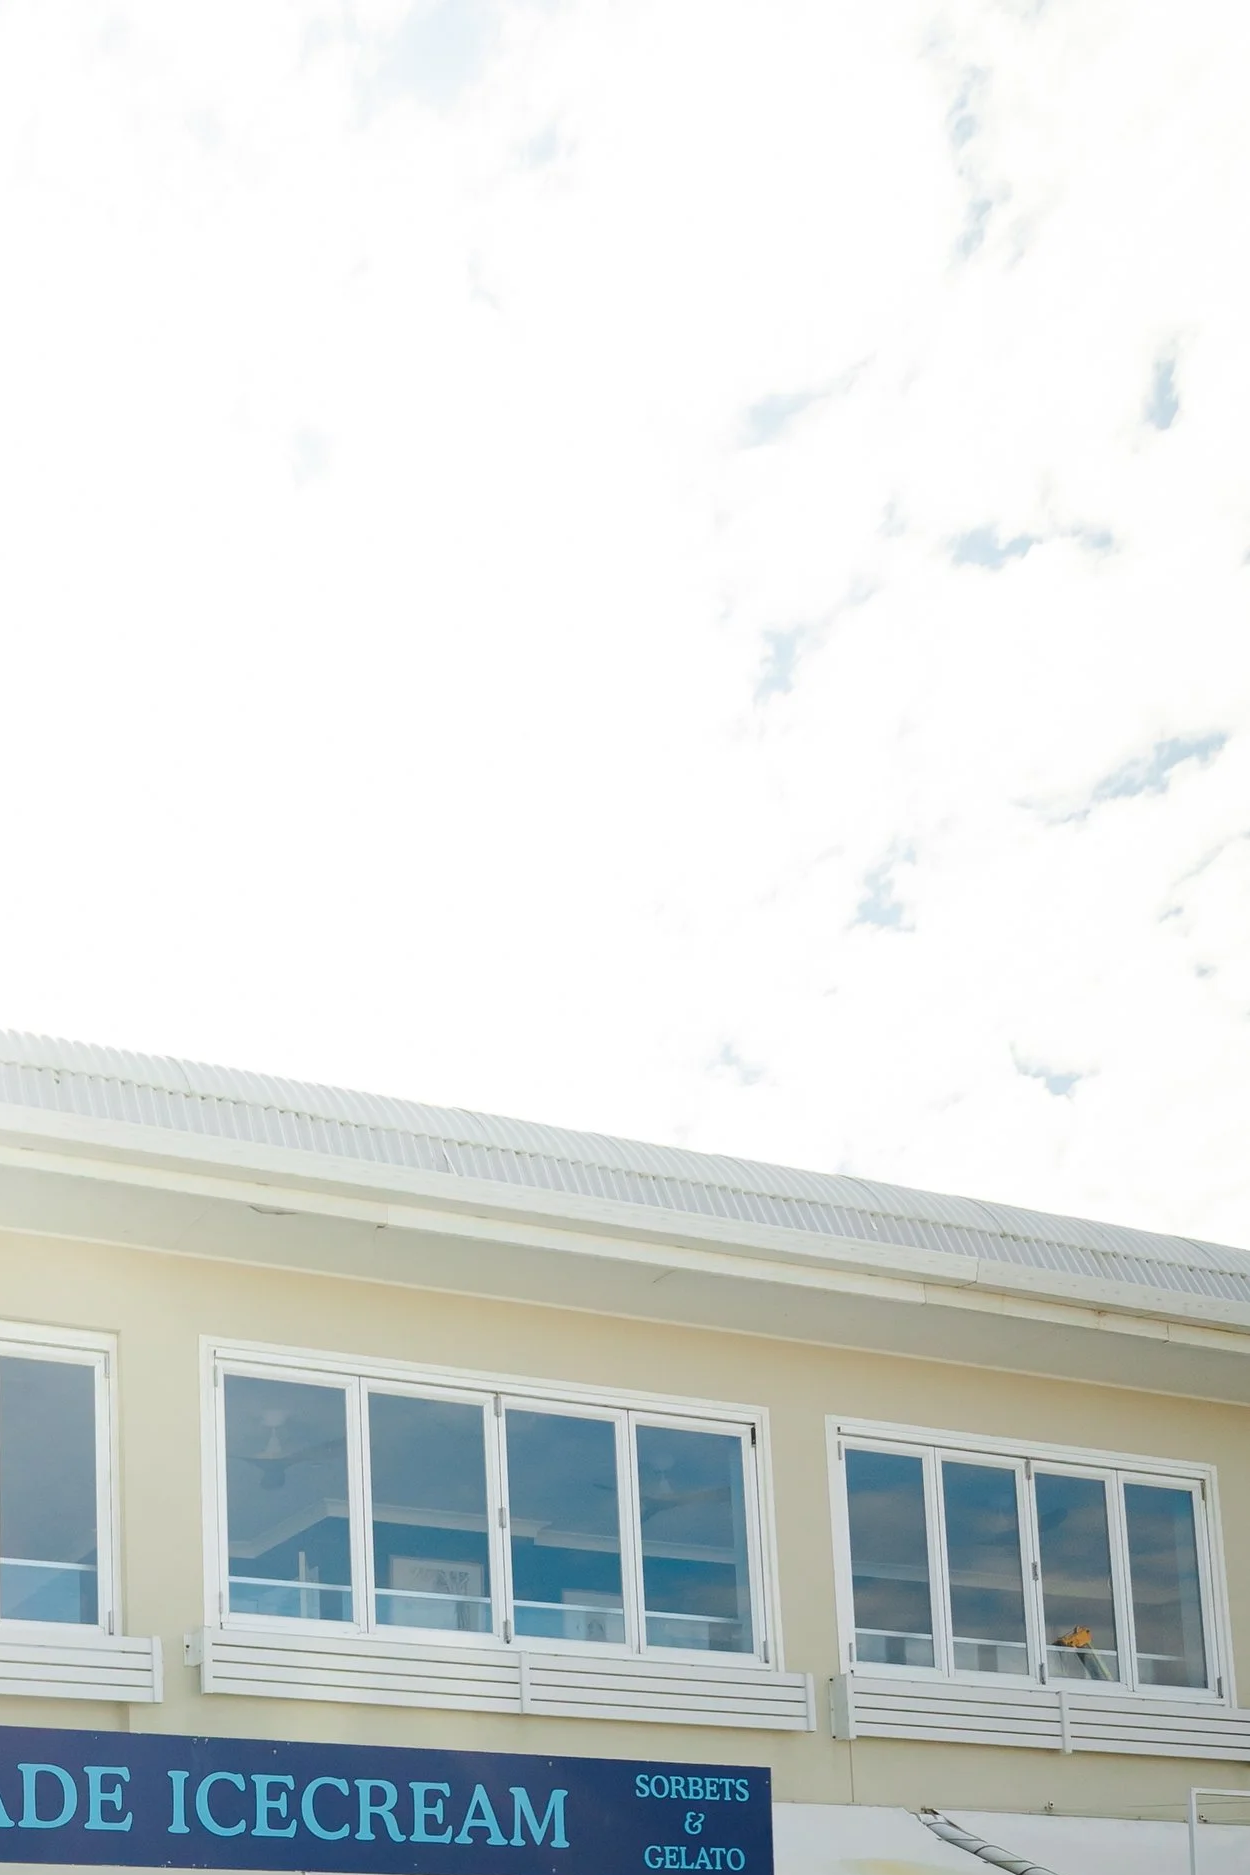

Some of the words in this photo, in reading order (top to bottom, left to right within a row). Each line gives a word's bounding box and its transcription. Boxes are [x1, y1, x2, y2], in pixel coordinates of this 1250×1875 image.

[634, 1773, 750, 1803] SORBETS
[167, 1769, 570, 1849] ICECREAM
[684, 1811, 704, 1836] &
[643, 1845, 747, 1872] GELATO
